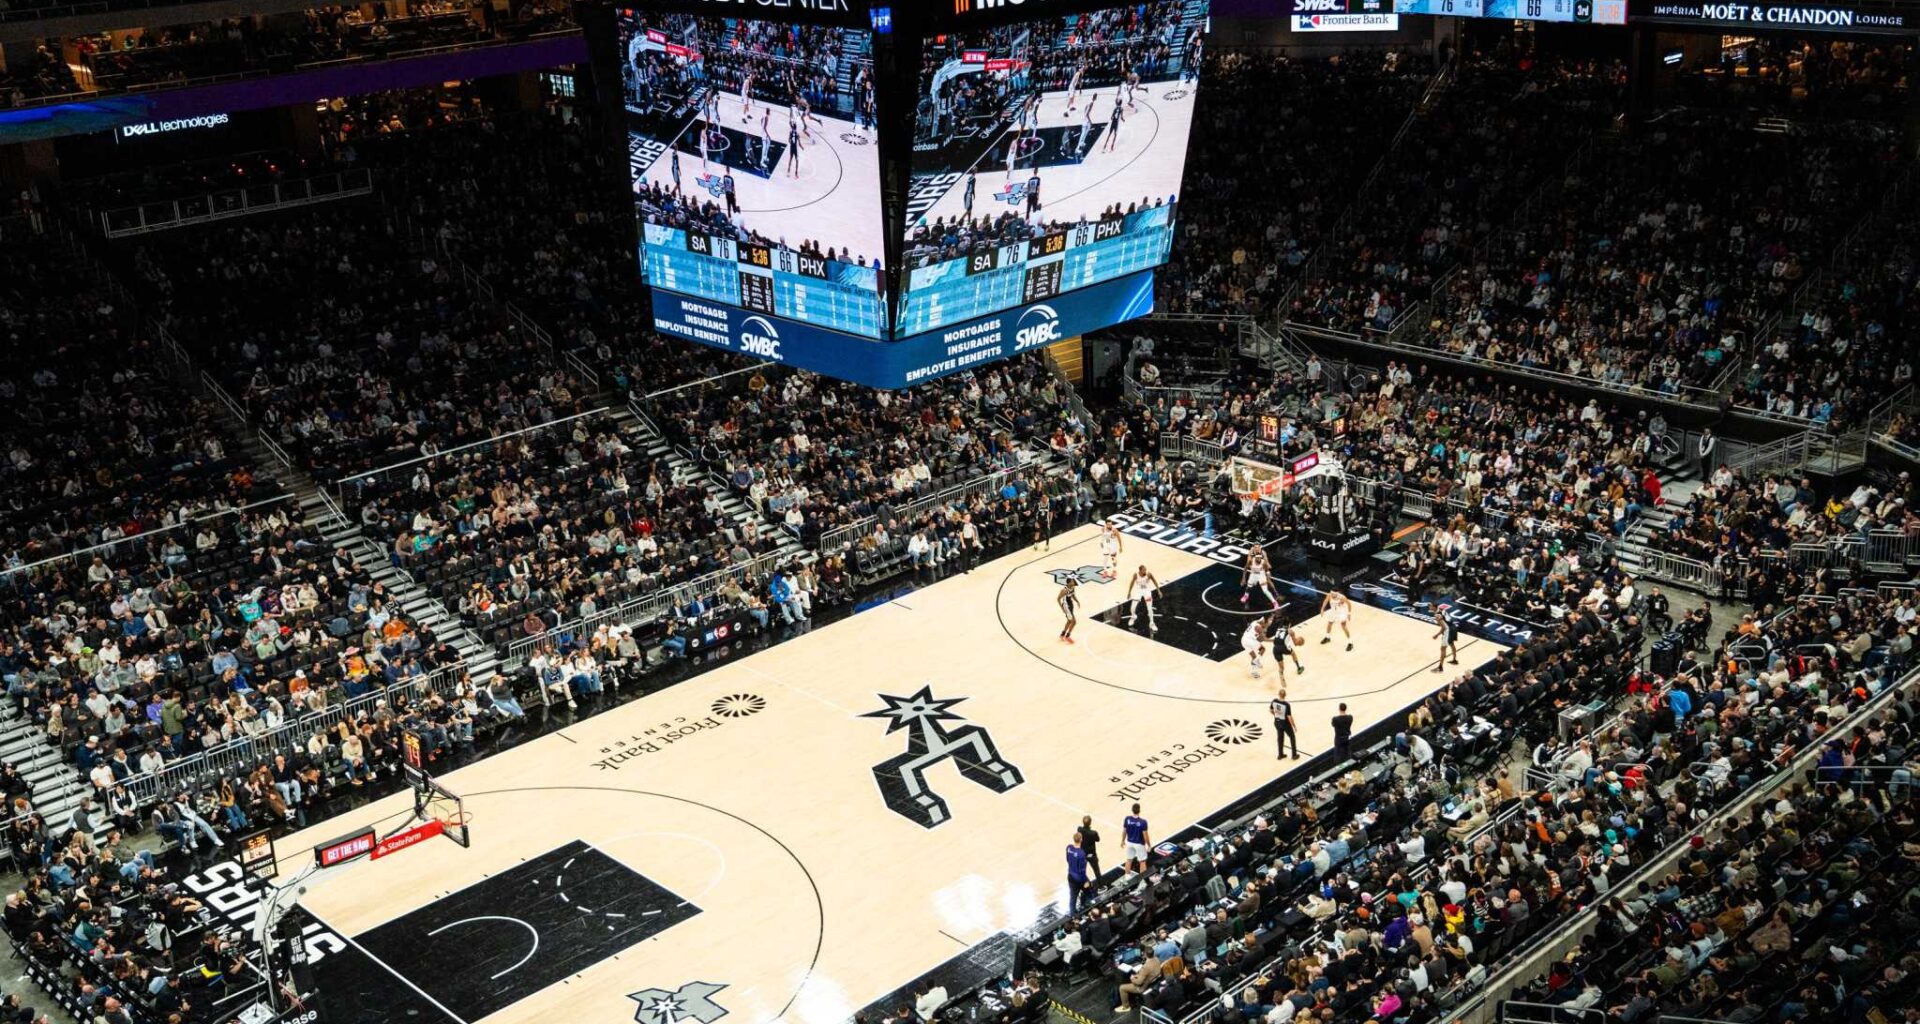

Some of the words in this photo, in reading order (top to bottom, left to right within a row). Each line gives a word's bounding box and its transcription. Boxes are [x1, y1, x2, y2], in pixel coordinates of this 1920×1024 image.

[1322, 16, 1361, 25] Frontier
[1363, 15, 1389, 25] Bank
[1577, 5, 1589, 16] 3rd
[1654, 5, 1700, 16] IMPÉRIAL
[1701, 3, 1749, 21] MOËT
[1751, 7, 1763, 22] &
[1766, 7, 1853, 26] CHANDON
[1856, 16, 1903, 26] LOUNGE
[123, 122, 159, 137] DELL
[159, 113, 229, 132] Technologies
[691, 235, 707, 252] SA
[717, 238, 729, 260] 76
[752, 247, 769, 266] 5:36
[779, 251, 792, 273] 66
[800, 257, 825, 278] PHX
[973, 253, 991, 271] SA
[1006, 244, 1020, 265] 76
[1045, 234, 1064, 253] 5:36
[1075, 226, 1089, 247] 66
[1096, 218, 1123, 239] PHX
[681, 301, 728, 320] MORTGAGES
[685, 314, 729, 333] INSURANCE
[654, 319, 693, 337] EMPLOYEE
[694, 328, 730, 346] BENEFITS
[944, 319, 1001, 344] MORTGAGES
[947, 332, 1002, 356] INSURANCE
[1014, 320, 1059, 351] SWBC
[740, 332, 781, 360] SWBC
[906, 358, 956, 382] EMPLOYEE
[957, 346, 1002, 370] BENEFITS
[1097, 513, 1250, 562] SPURS
[1342, 533, 1370, 550] coinbase
[1450, 608, 1533, 640] ULTRA
[599, 716, 687, 754] CENTER
[655, 716, 723, 744] Frost
[589, 741, 663, 771] Bank
[1108, 743, 1185, 783] CENTER
[1163, 743, 1229, 773] Frost
[1107, 770, 1176, 802] Bank
[248, 834, 268, 849] 5:36
[327, 848, 340, 861] GET
[291, 935, 301, 946] GET
